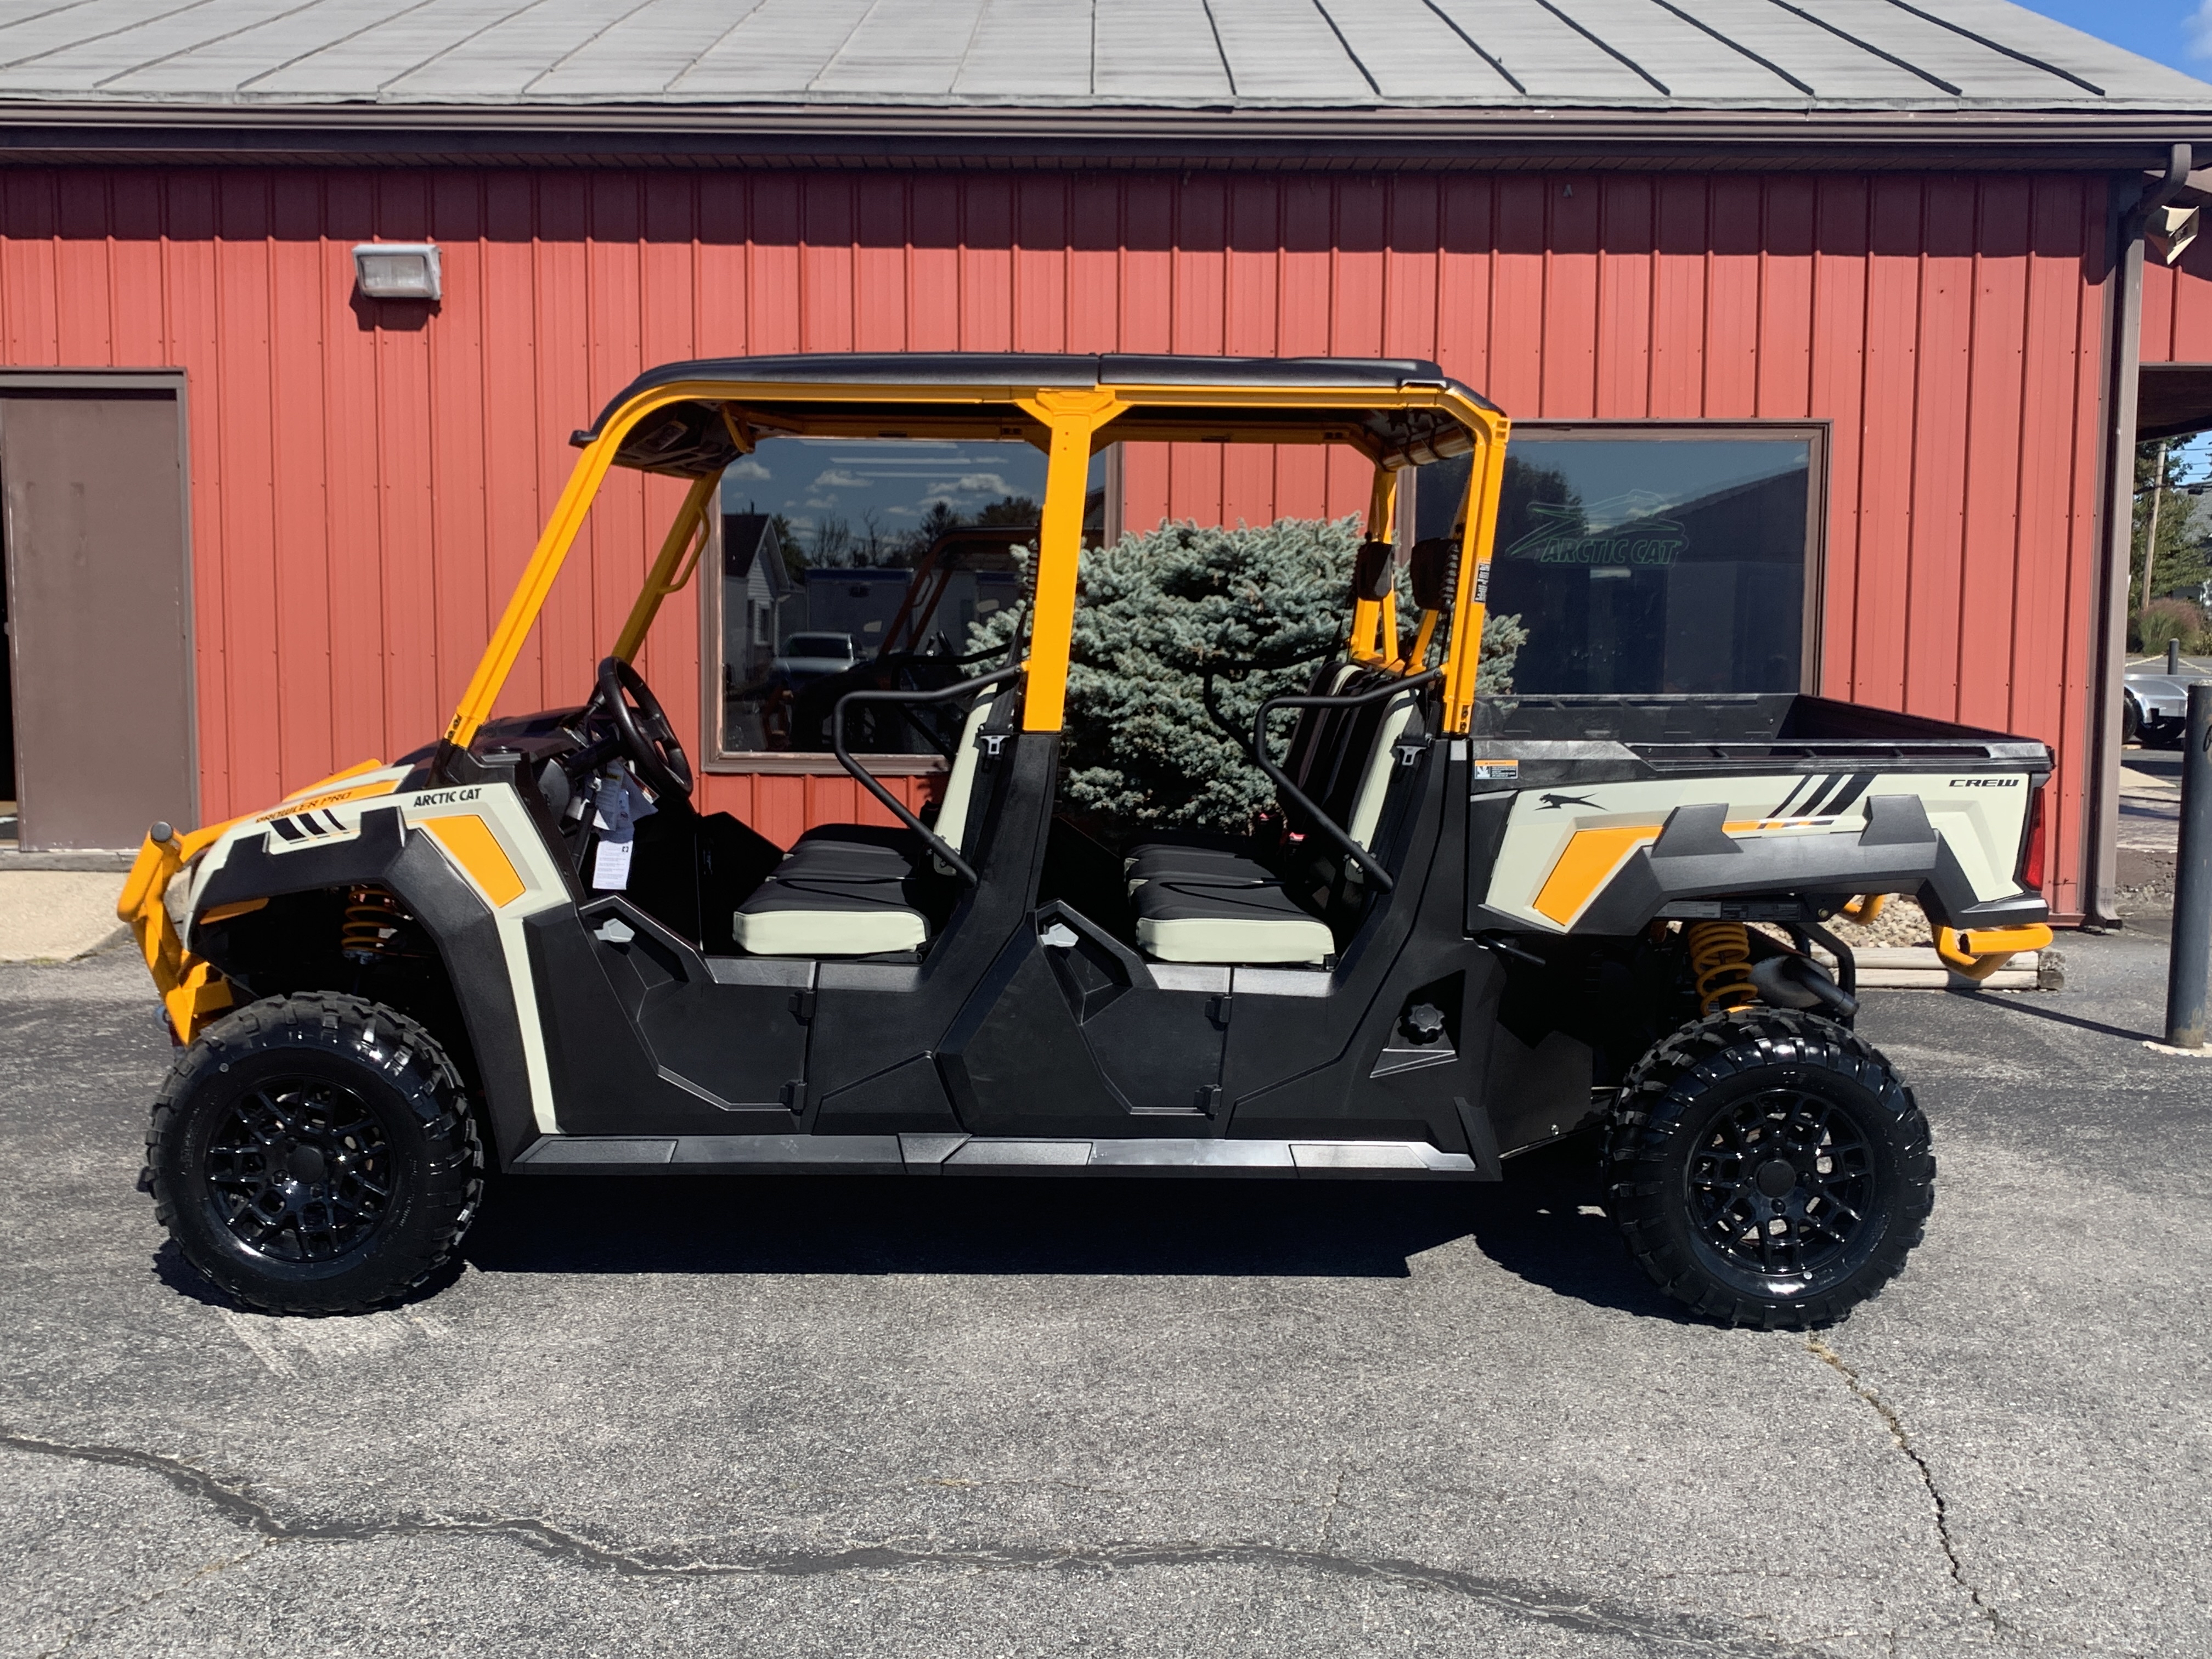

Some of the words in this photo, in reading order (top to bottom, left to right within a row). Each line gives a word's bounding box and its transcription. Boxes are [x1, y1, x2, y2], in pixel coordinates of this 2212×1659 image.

[1541, 538, 1628, 563] ARCTIC
[1630, 539, 1680, 565] CAT
[320, 792, 352, 805] PRO
[413, 792, 456, 808] ARCTIC
[459, 788, 482, 801] CAT
